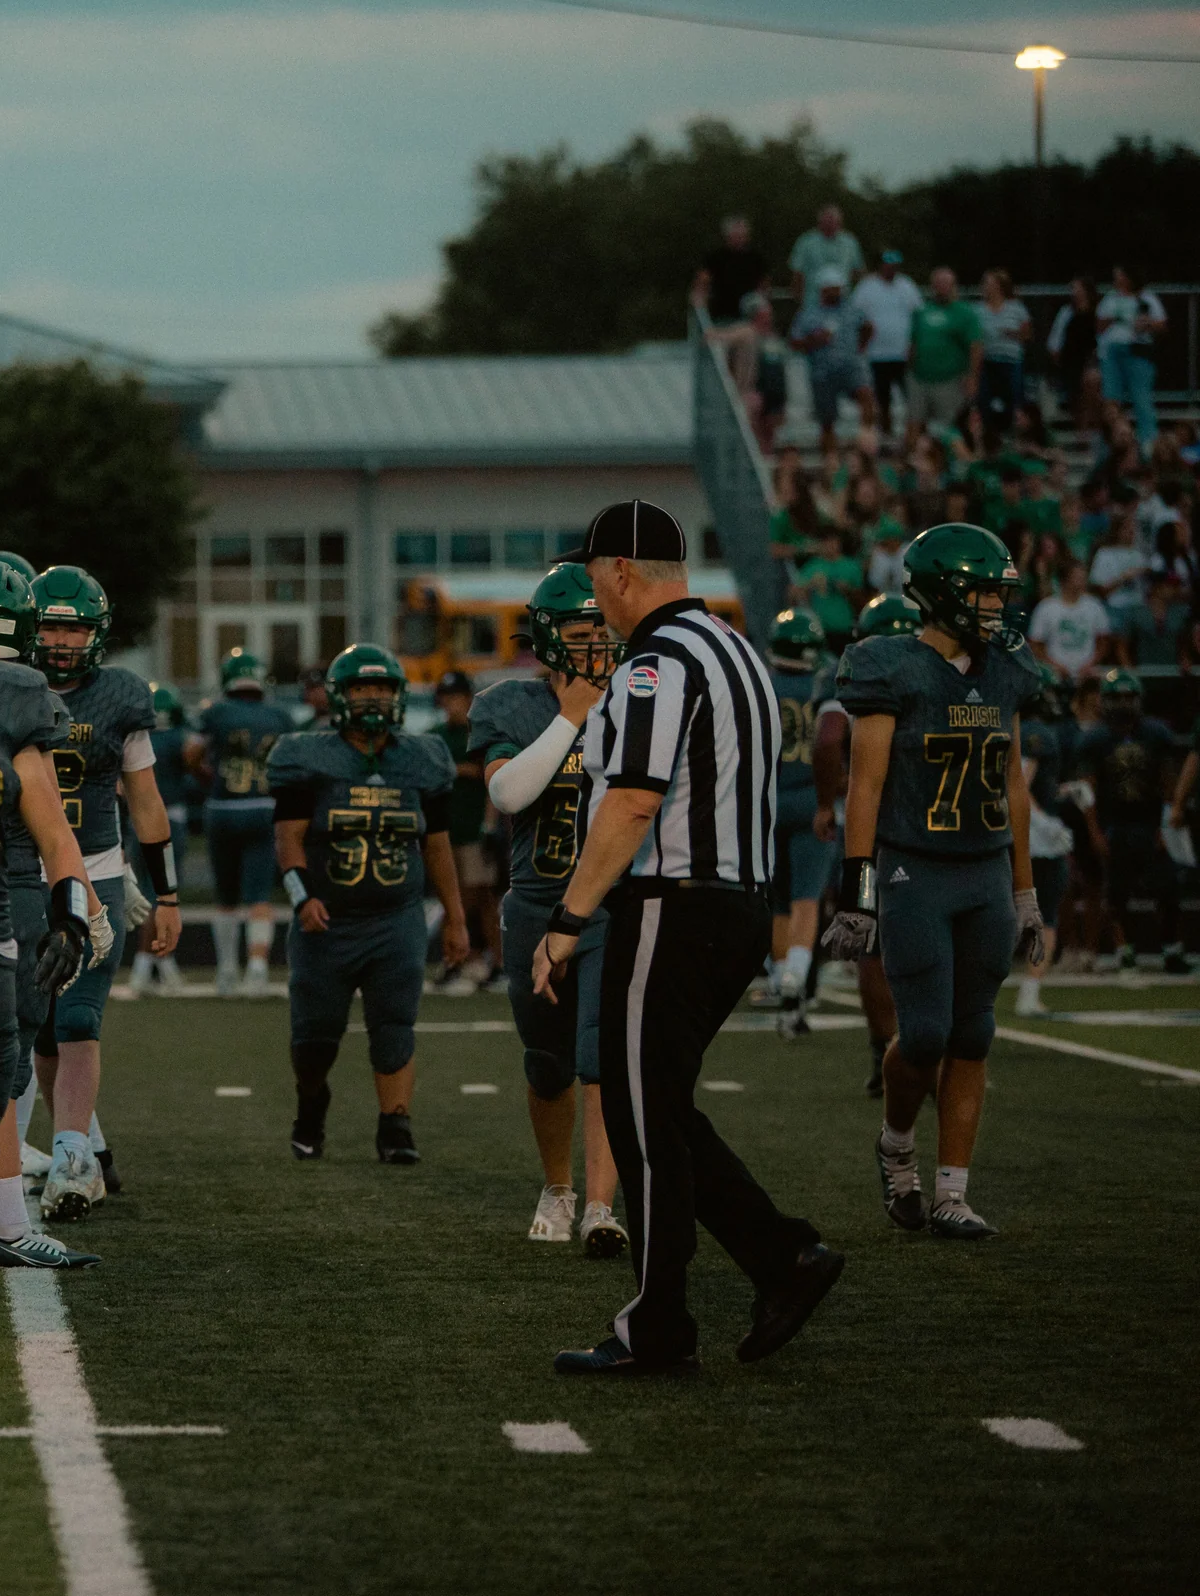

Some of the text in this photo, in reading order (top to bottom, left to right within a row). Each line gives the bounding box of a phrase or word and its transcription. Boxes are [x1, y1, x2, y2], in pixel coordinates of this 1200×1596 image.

[948, 706, 1001, 727] IRISH
[923, 732, 1011, 831] 79
[325, 808, 419, 887] 55
